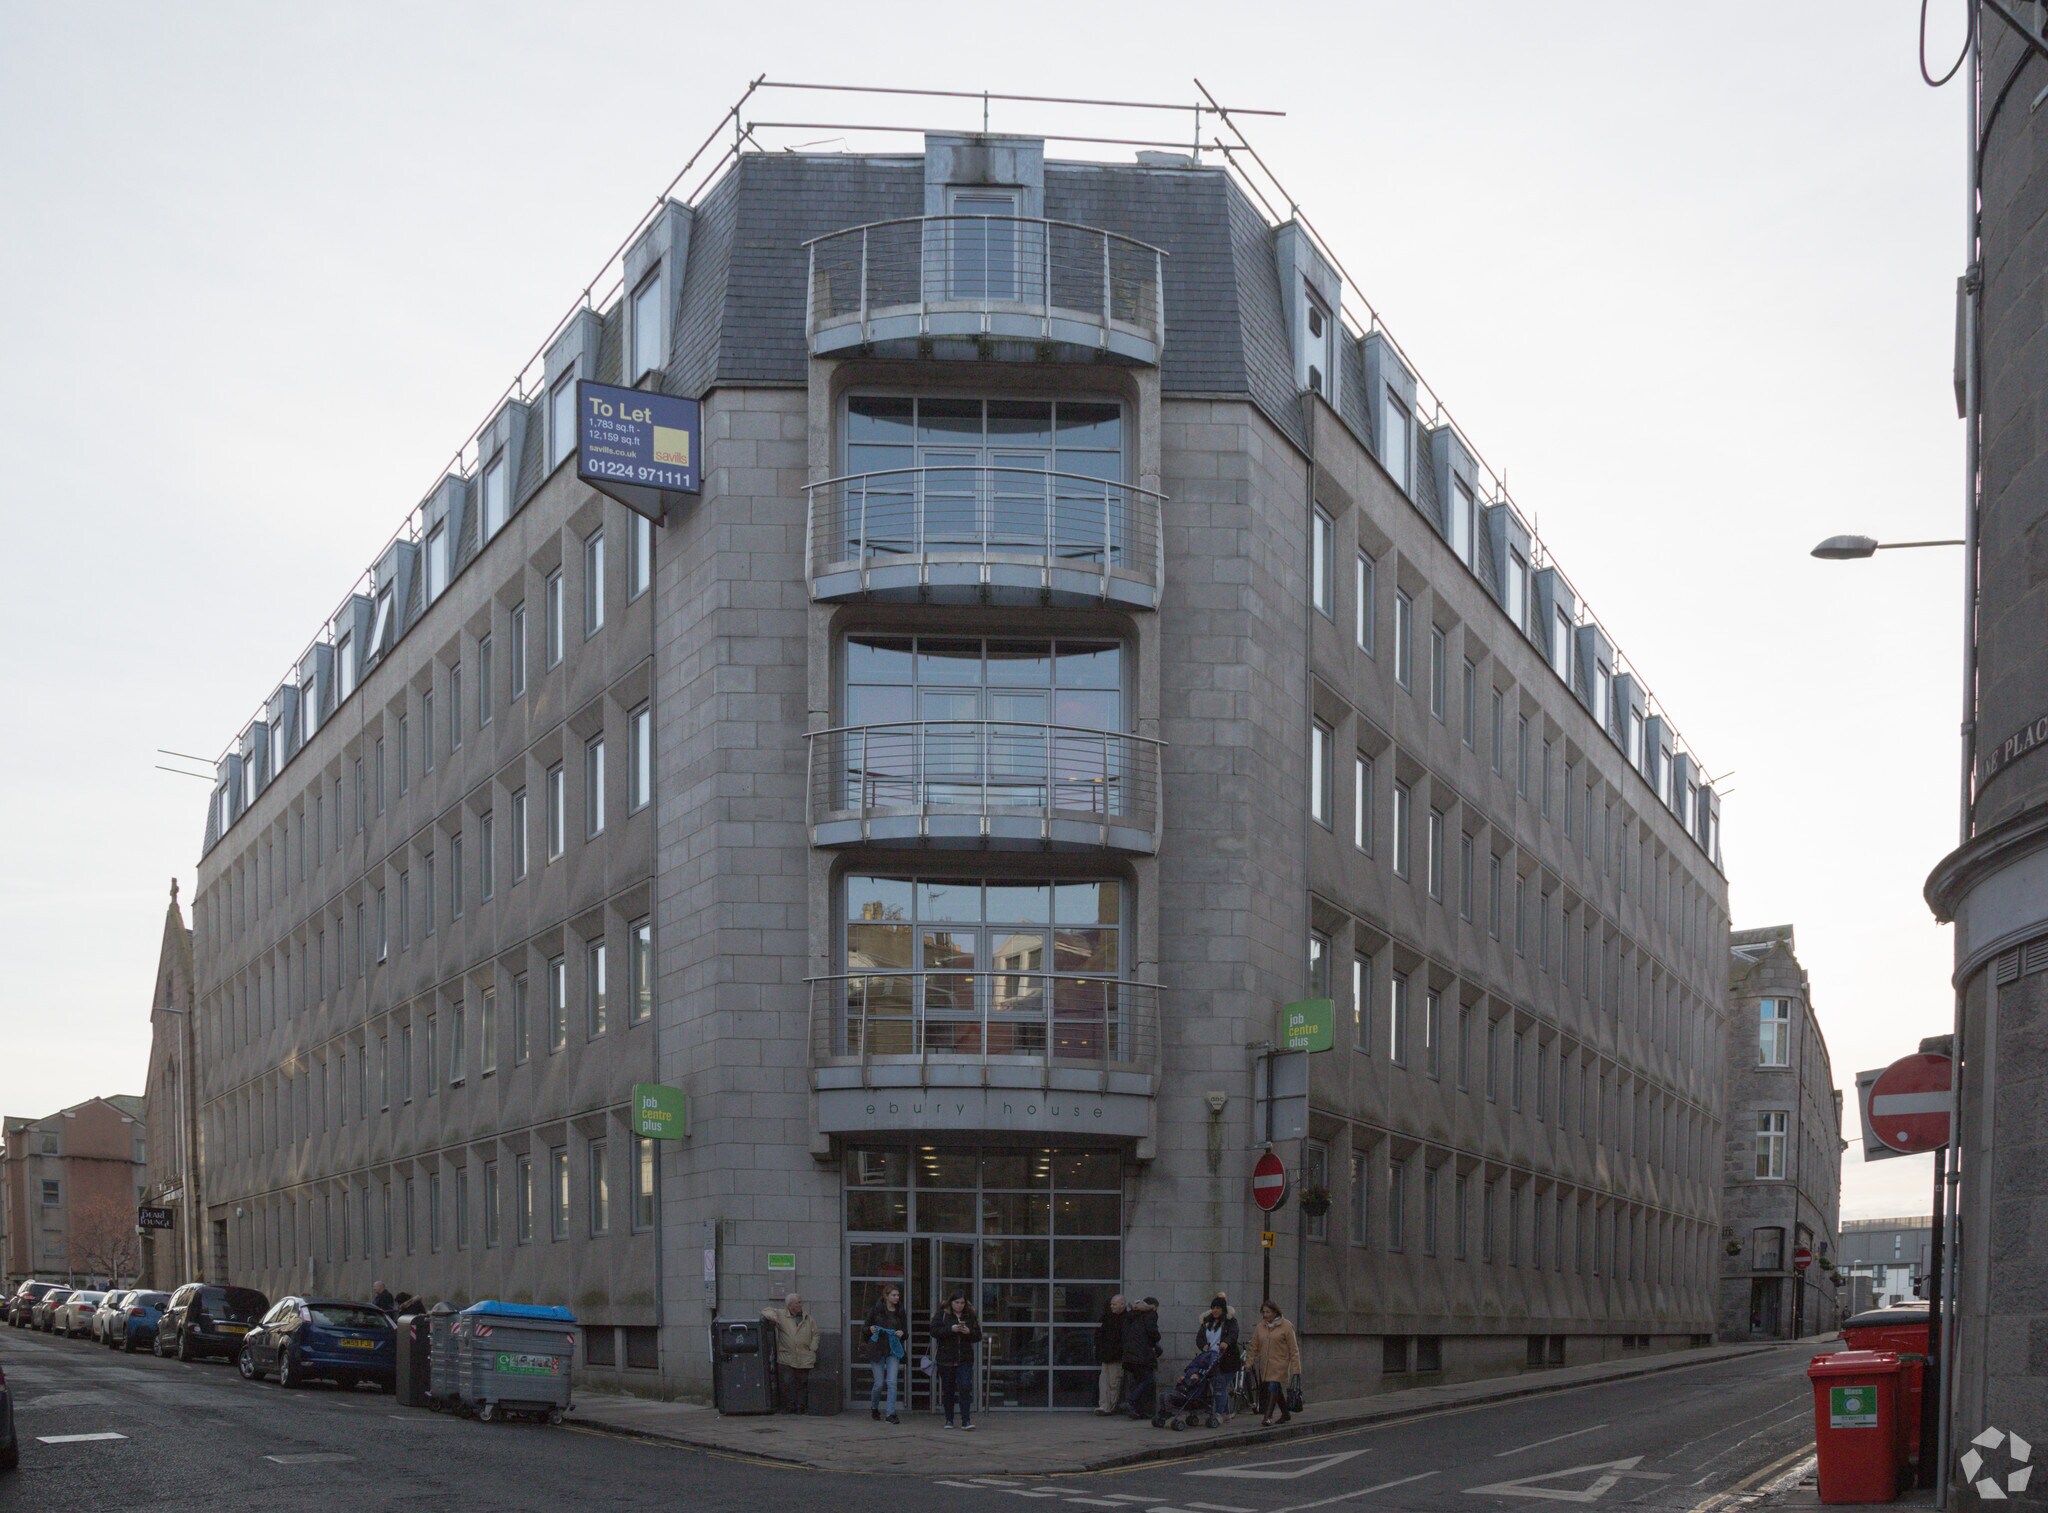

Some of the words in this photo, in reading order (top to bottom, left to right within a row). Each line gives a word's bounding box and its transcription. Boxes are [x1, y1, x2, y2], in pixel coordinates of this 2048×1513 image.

[588, 397, 613, 417] To
[620, 402, 652, 424] Let
[589, 445, 637, 458] savills.co.uk
[655, 451, 688, 464] savills
[588, 459, 634, 478] 01224
[638, 466, 690, 487] 971111
[1289, 1013, 1305, 1028] job
[1288, 1024, 1319, 1037] centre
[1289, 1036, 1309, 1048] plus
[642, 1095, 658, 1109] job
[641, 1109, 673, 1122] centre
[866, 1101, 965, 1116] ebury
[1003, 1101, 1103, 1118] house
[642, 1120, 663, 1132] plus
